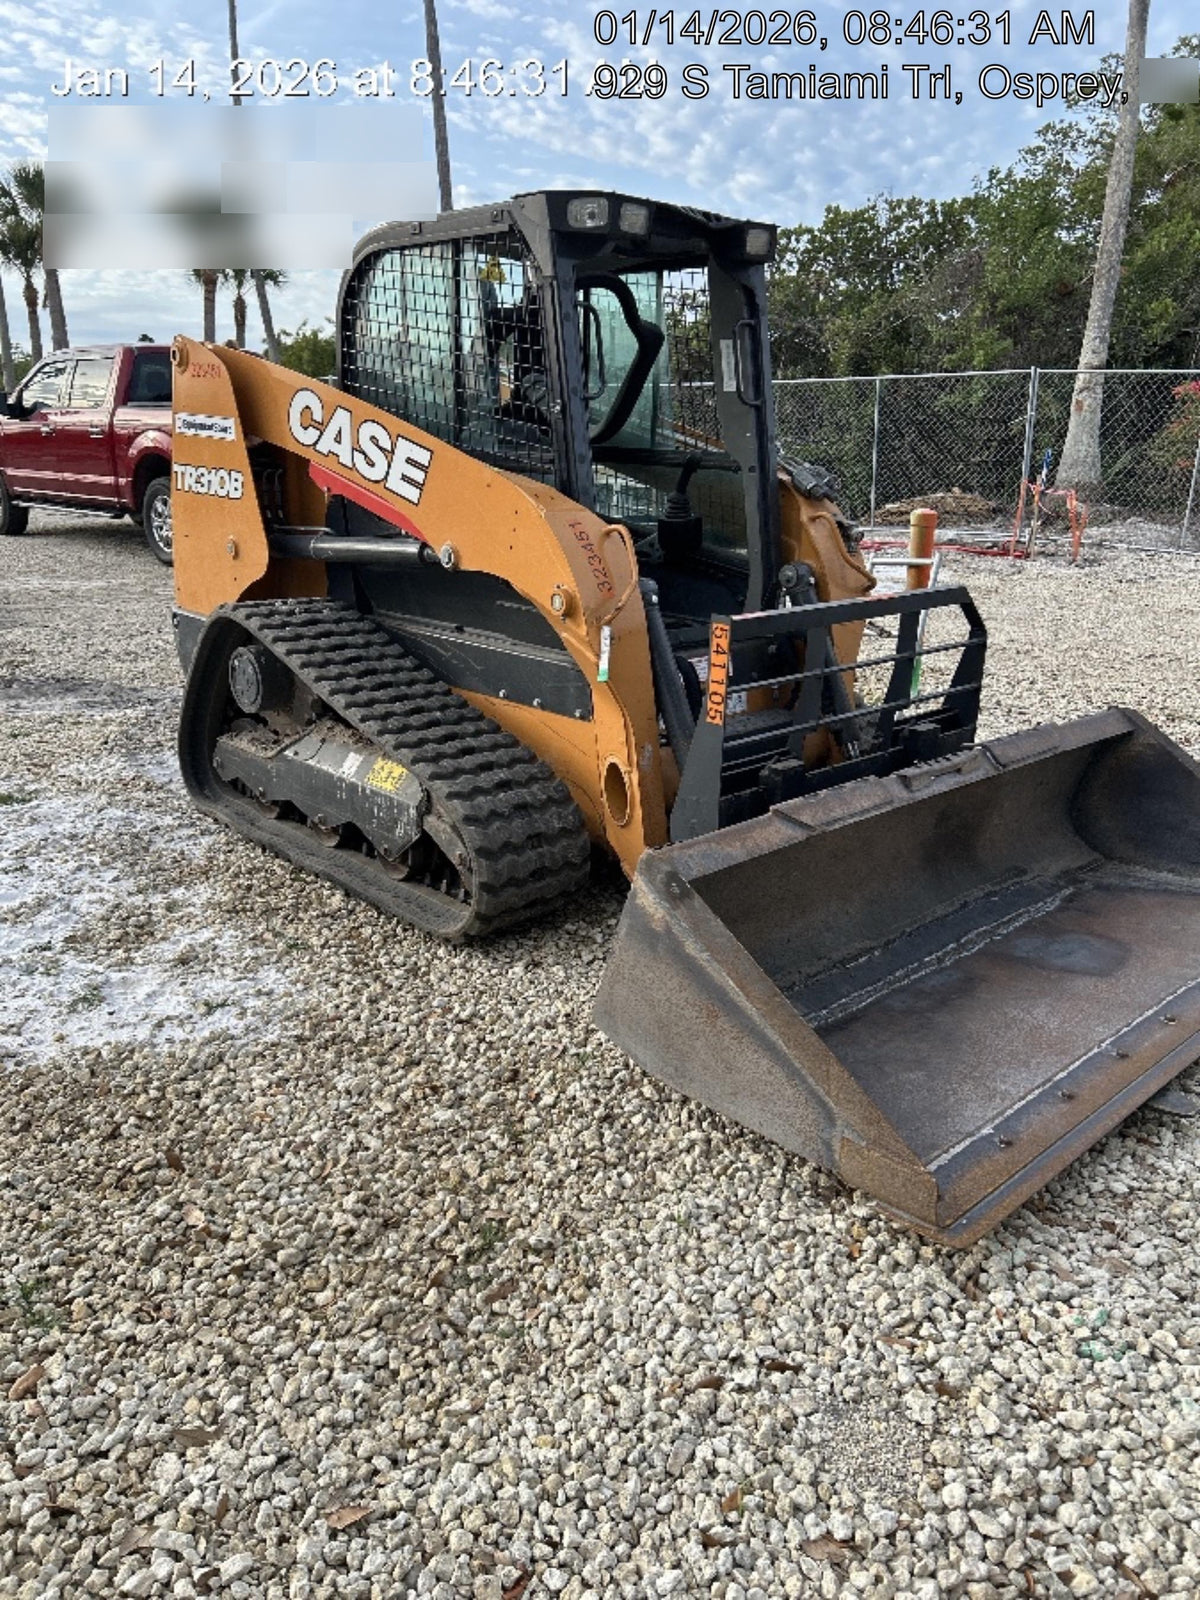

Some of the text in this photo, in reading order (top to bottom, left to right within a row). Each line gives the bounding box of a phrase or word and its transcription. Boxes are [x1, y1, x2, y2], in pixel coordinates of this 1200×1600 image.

[173, 462, 244, 500] TR310B
[288, 387, 434, 505] CASE
[568, 520, 614, 594] 323451
[707, 624, 729, 721] 541105
